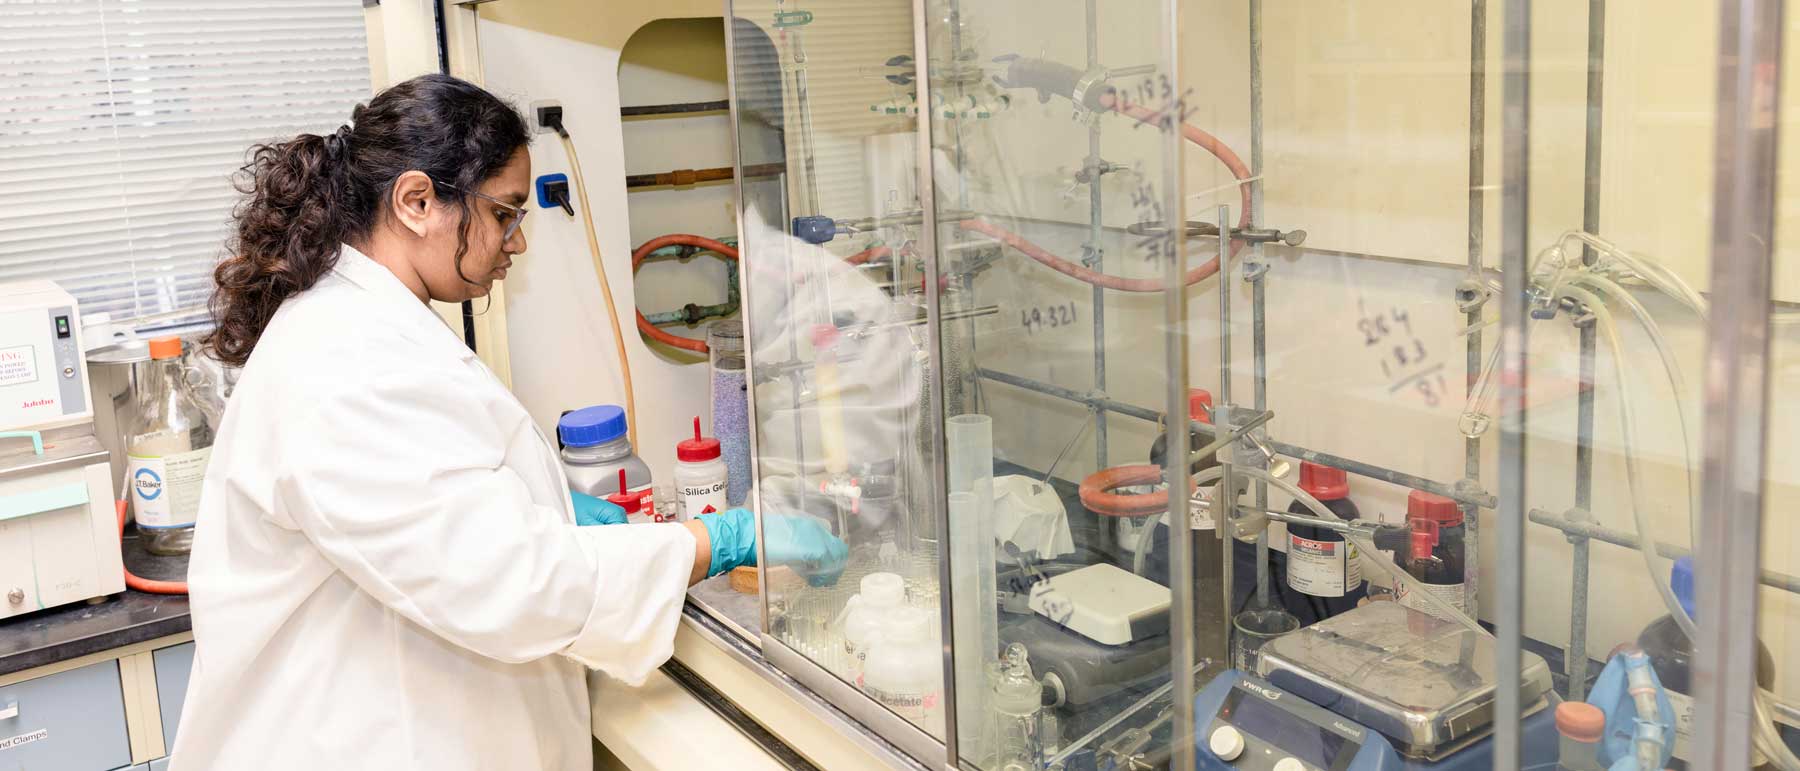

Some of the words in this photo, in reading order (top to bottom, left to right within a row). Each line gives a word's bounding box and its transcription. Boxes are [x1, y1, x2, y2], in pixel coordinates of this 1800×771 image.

[1021, 301, 1077, 335] 49.321
[0, 352, 24, 361] ING:
[685, 488, 711, 496] Silica
[712, 481, 725, 492] Gel
[1301, 541, 1322, 549] ACROS
[1243, 680, 1262, 693] VWR
[0, 740, 11, 749] nd
[13, 731, 47, 745] Clamps
